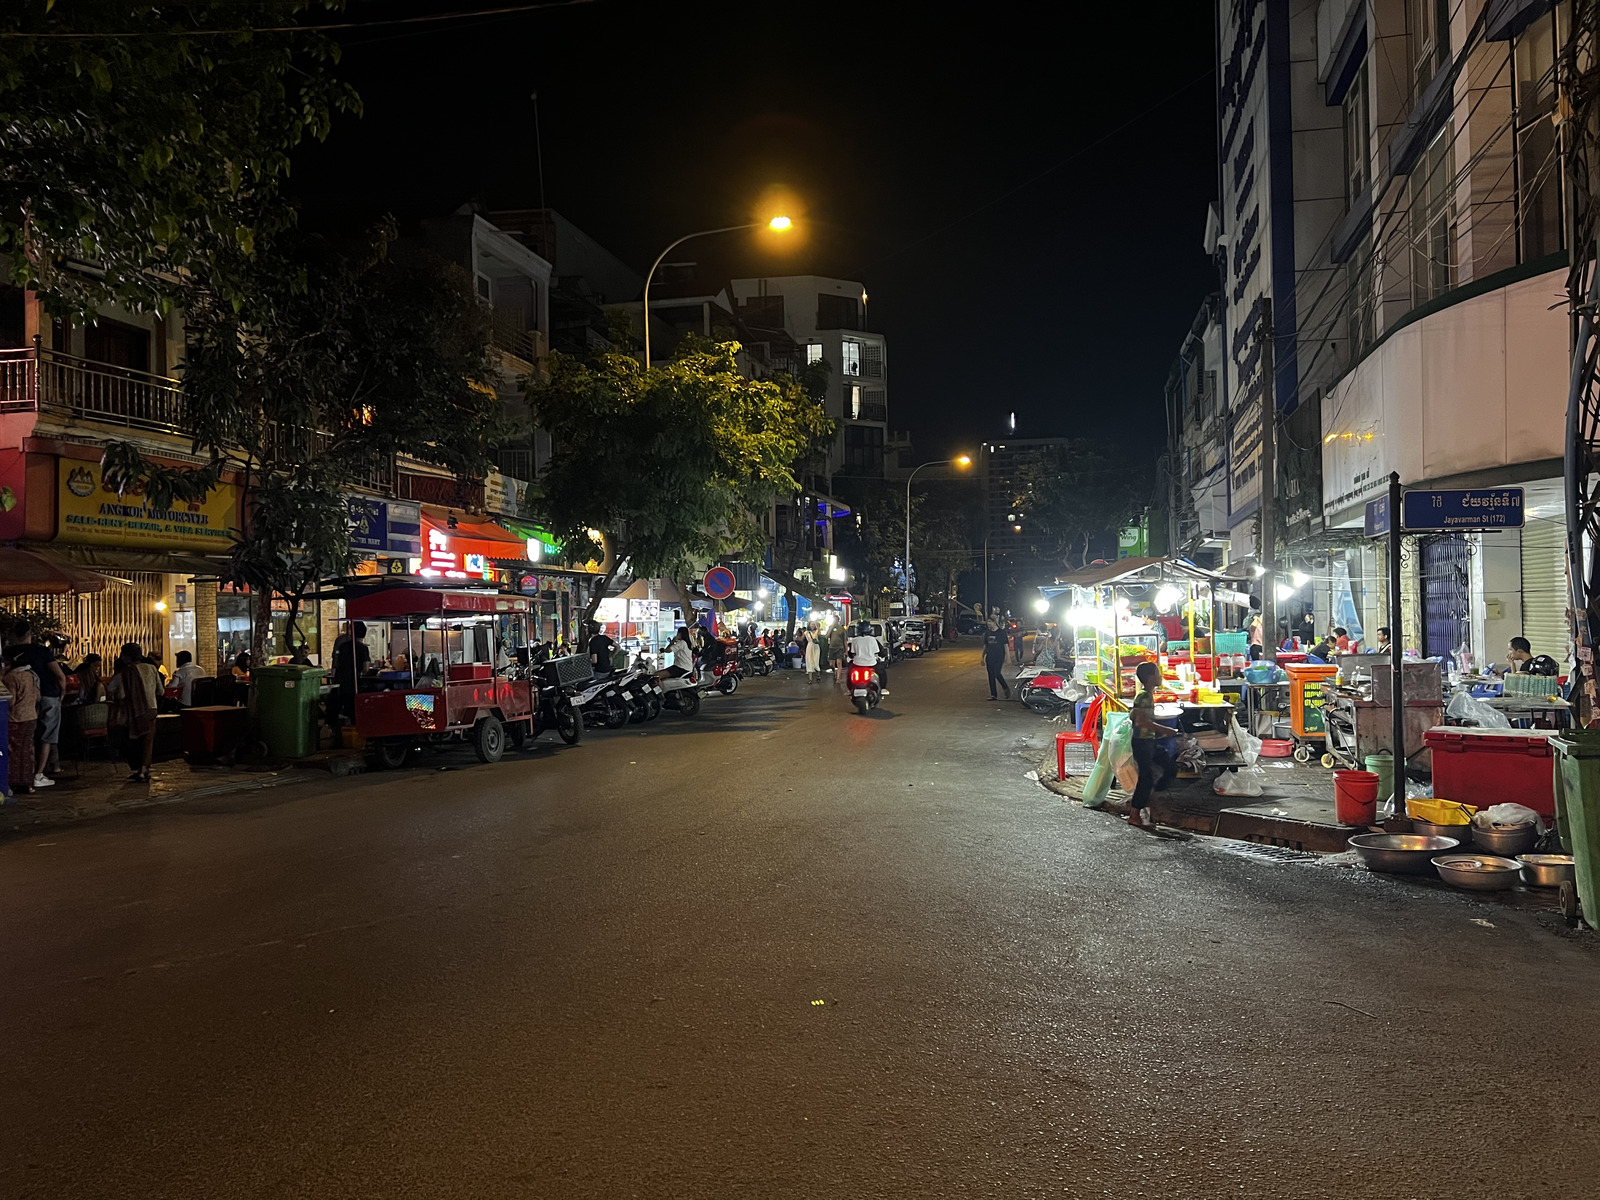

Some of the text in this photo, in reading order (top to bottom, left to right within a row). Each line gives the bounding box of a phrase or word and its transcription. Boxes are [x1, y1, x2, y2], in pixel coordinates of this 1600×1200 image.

[74, 474, 92, 483] AM
[99, 503, 143, 518] ANGKOR
[1444, 514, 1506, 525] Jayavarman St (172)
[174, 525, 193, 534] VISA
[1120, 535, 1137, 543] Wing
